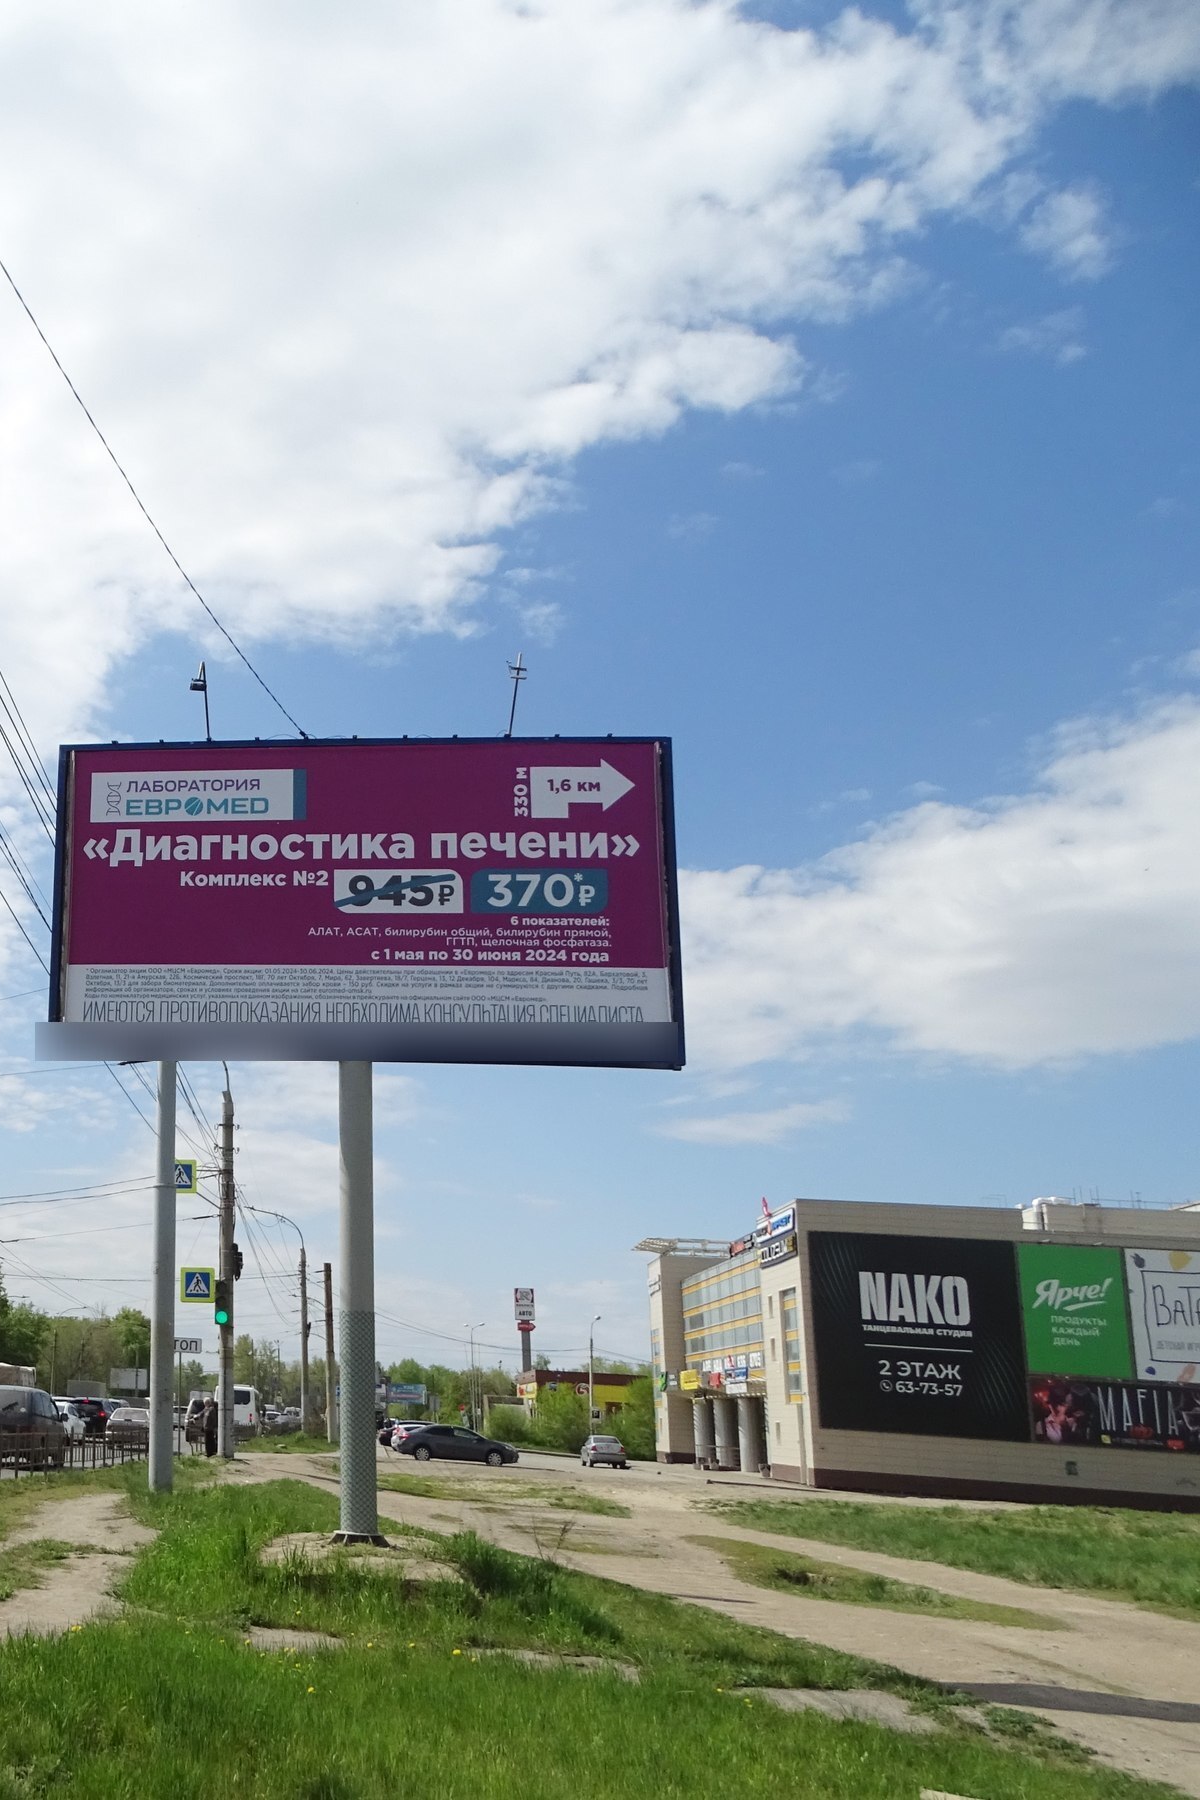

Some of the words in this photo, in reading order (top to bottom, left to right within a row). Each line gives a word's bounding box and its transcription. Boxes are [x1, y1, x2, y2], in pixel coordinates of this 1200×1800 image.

[126, 778, 261, 793] ЛАБОРАТОРИЯ
[547, 778, 571, 794] 1,6
[577, 781, 601, 792] км
[514, 783, 528, 817] 330
[83, 828, 415, 867] «Диагностика
[430, 831, 640, 860] печени»
[180, 871, 286, 888] Комплекс
[293, 870, 328, 887] №2
[510, 916, 519, 926] 6
[522, 915, 610, 926] показателей:
[308, 927, 343, 937] АЛАТ,
[346, 927, 382, 937] АСАТ,
[384, 927, 447, 938] билирубин
[451, 927, 493, 938] общий,
[496, 927, 560, 938] билирубин
[564, 928, 612, 938] прямой,
[446, 937, 478, 947] ГГТП,
[481, 938, 540, 947] щелочная
[543, 938, 612, 949] фосфатаза.
[371, 950, 380, 960] с
[383, 948, 390, 960] 1
[394, 950, 424, 960] мая
[428, 950, 448, 960] по
[452, 949, 473, 961] 30
[477, 951, 521, 961] июня
[525, 949, 567, 961] 2024
[571, 951, 609, 963] года
[83, 1000, 155, 1022] ИМЕЮТСЯ
[160, 1000, 321, 1023] ПРОТИВОПОКАЗАНИЯ
[858, 1271, 971, 1326] NAKO
[1032, 1277, 1113, 1310] Ярче!
[1050, 1315, 1107, 1326] ПРОДУКТЫ
[862, 1324, 934, 1335] ТАНЦЕВАЛЬНАЯ
[936, 1328, 973, 1339] СТУДИЯ
[1051, 1326, 1100, 1337] КАЖДЫЙ
[1053, 1337, 1081, 1347] ДЕНЬ
[878, 1360, 892, 1375] 2
[896, 1361, 961, 1380] ЭТАЖ
[895, 1381, 963, 1396] 63-73-57
[1097, 1386, 1179, 1436] MAFIA
